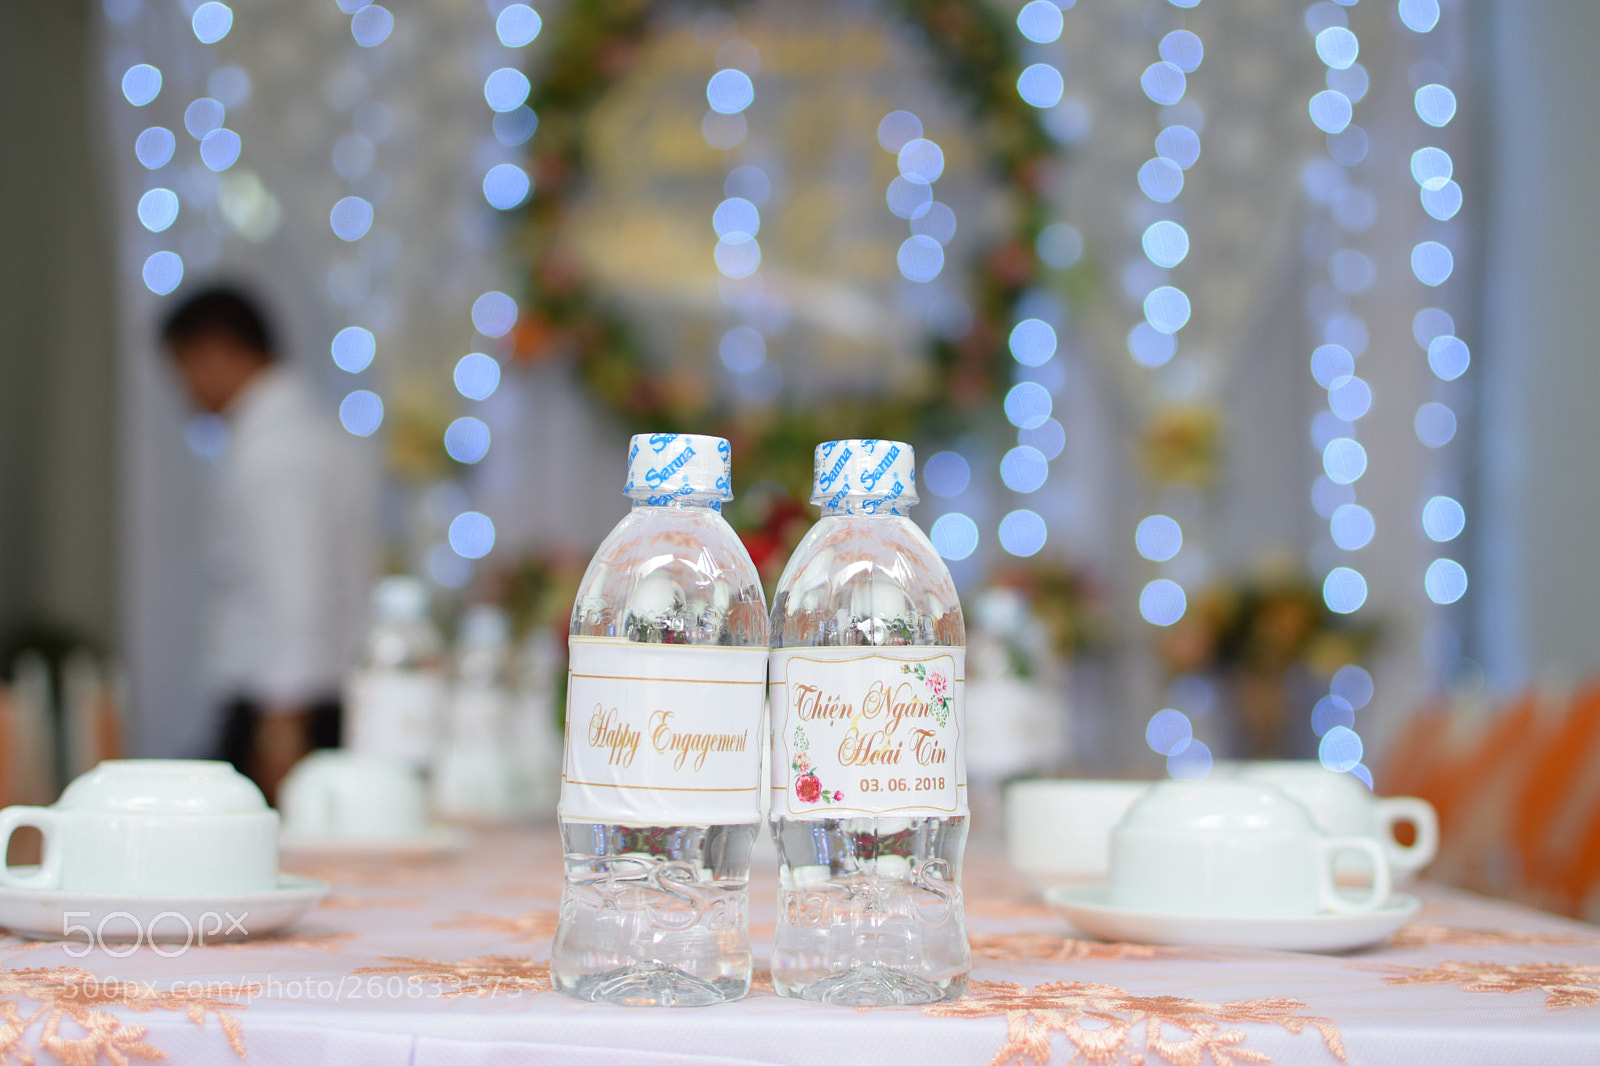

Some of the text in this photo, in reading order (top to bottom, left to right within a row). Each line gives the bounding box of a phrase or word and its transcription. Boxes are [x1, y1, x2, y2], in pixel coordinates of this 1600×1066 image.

[645, 446, 697, 490] Sanna
[820, 448, 853, 492] Sanna
[860, 445, 900, 492] Sanna
[588, 702, 748, 772] Happy Engagement
